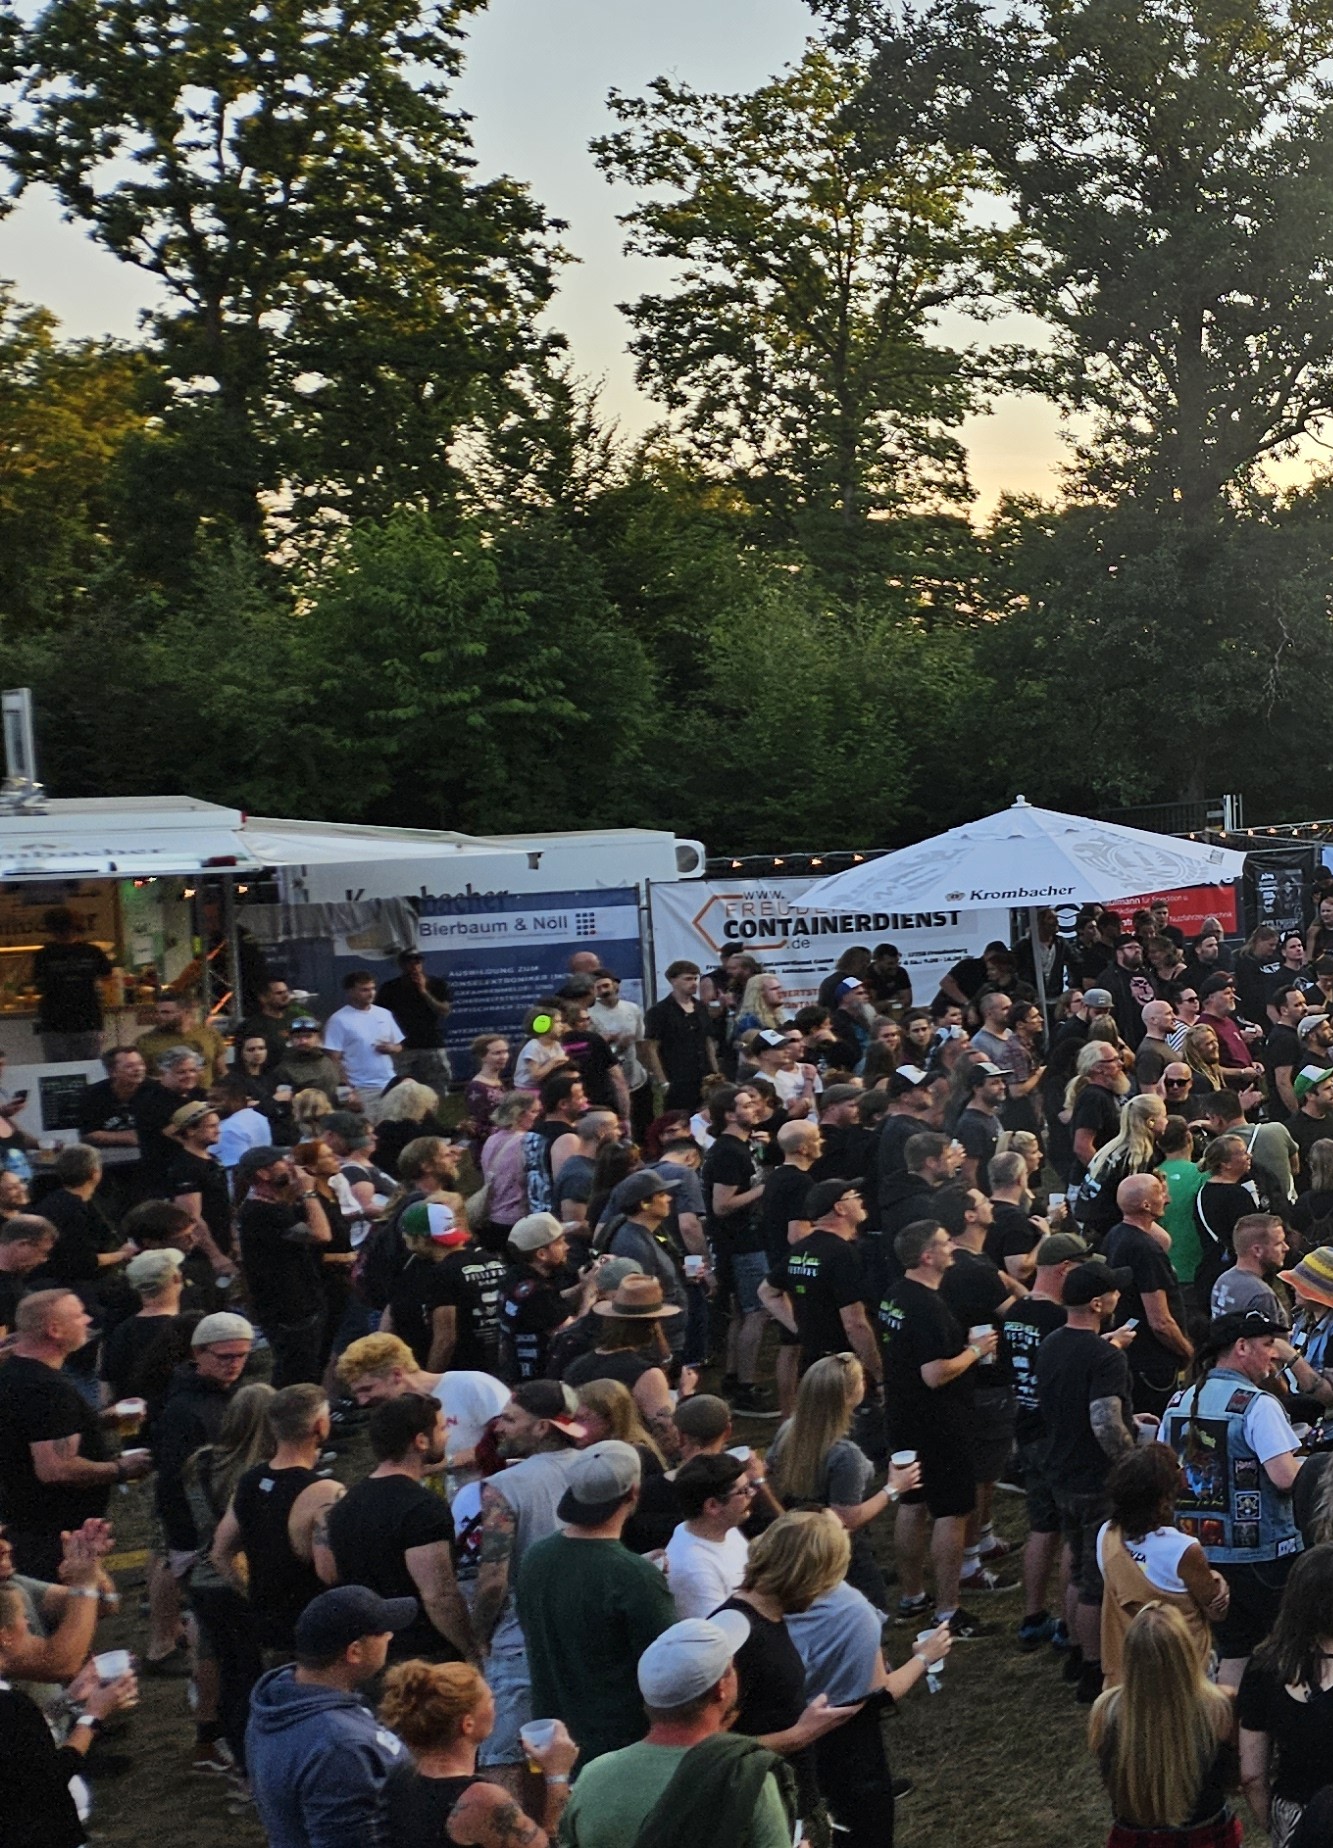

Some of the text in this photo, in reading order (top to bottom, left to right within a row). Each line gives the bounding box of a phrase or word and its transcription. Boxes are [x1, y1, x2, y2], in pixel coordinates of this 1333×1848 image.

[970, 885, 1077, 902] Krombacher
[420, 921, 507, 938] Bierbaum
[514, 918, 527, 931] &
[533, 914, 568, 931] Nöll
[723, 910, 962, 939] CONTAINERDIENST
[787, 938, 810, 950] .de
